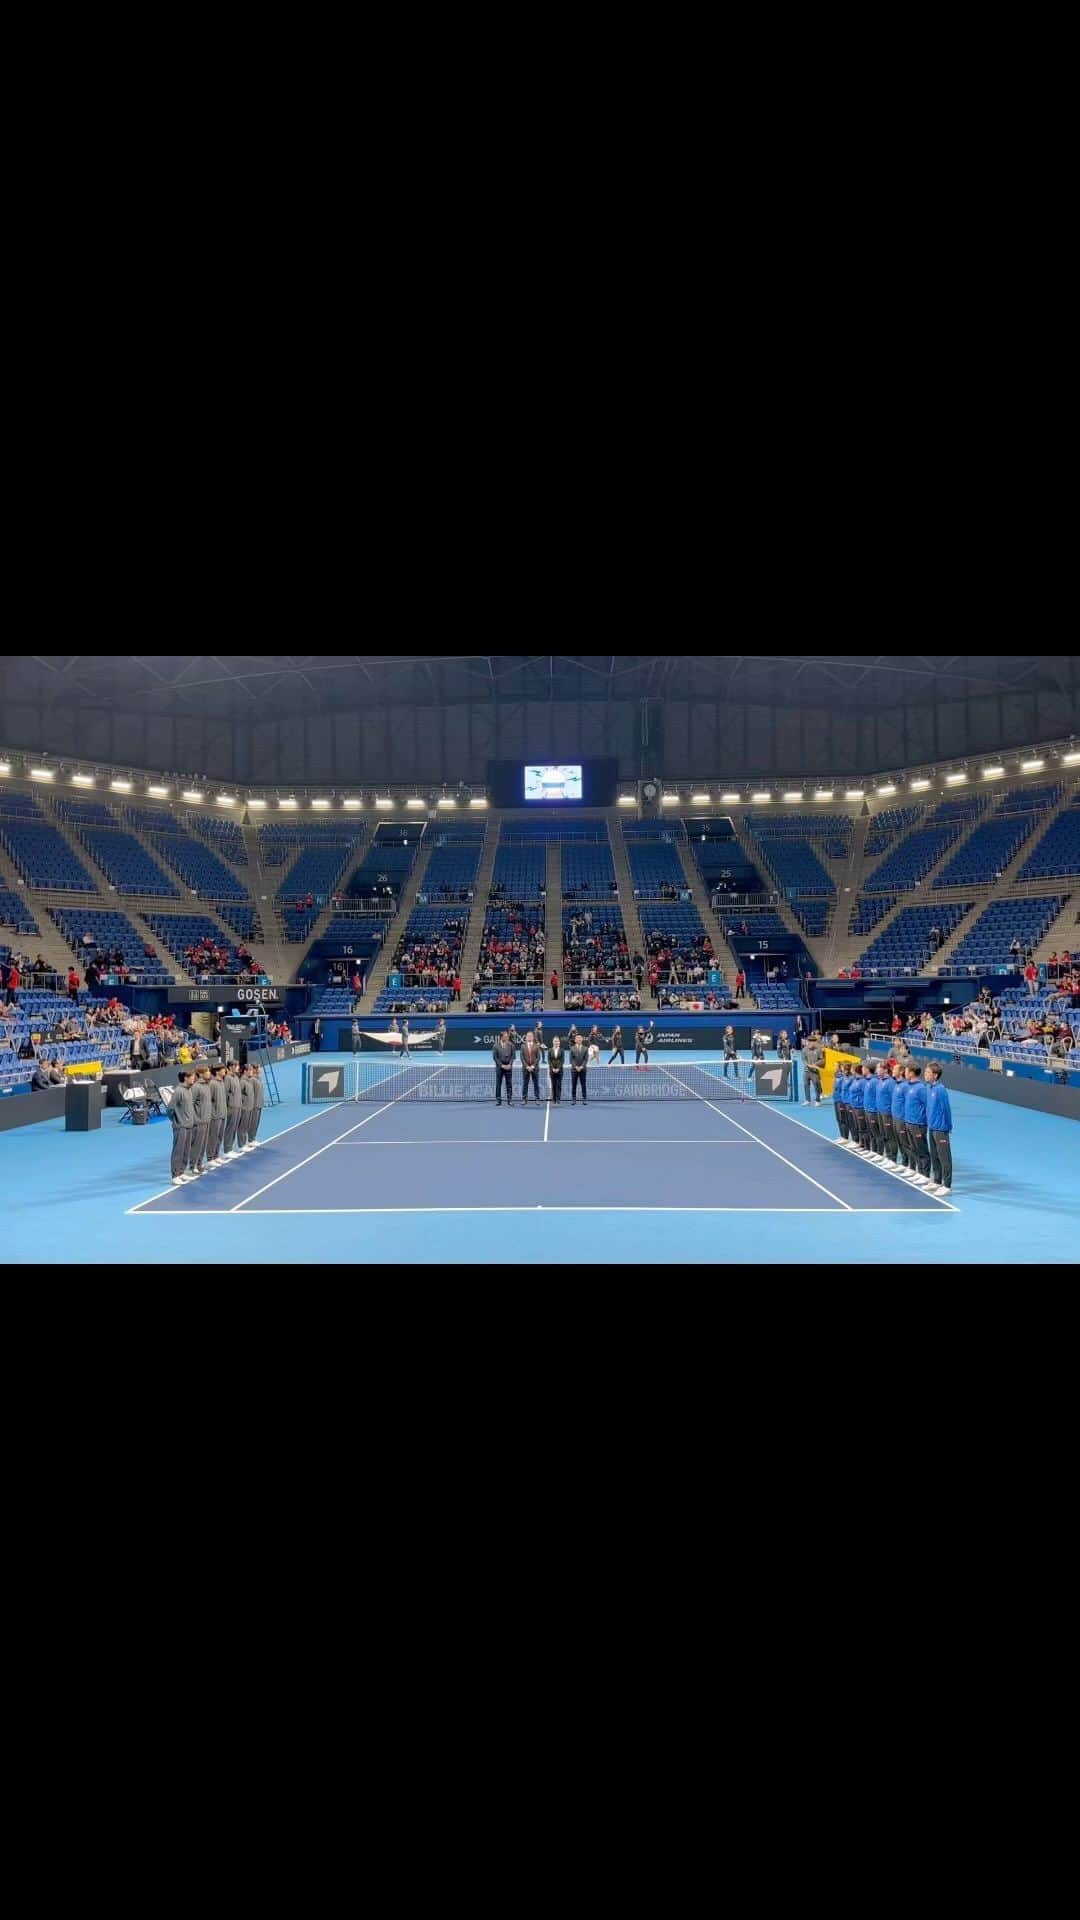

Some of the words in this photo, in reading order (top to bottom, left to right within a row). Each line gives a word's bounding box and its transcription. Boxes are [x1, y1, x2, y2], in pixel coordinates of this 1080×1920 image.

[377, 873, 388, 882] 26
[721, 869, 732, 878] 25
[757, 940, 769, 949] 15
[343, 945, 353, 954] 16
[333, 962, 343, 971] 16
[392, 978, 398, 986] E
[711, 974, 717, 982] E
[237, 988, 277, 1001] GOSEN
[614, 1084, 687, 1097] GAINBRIDGE
